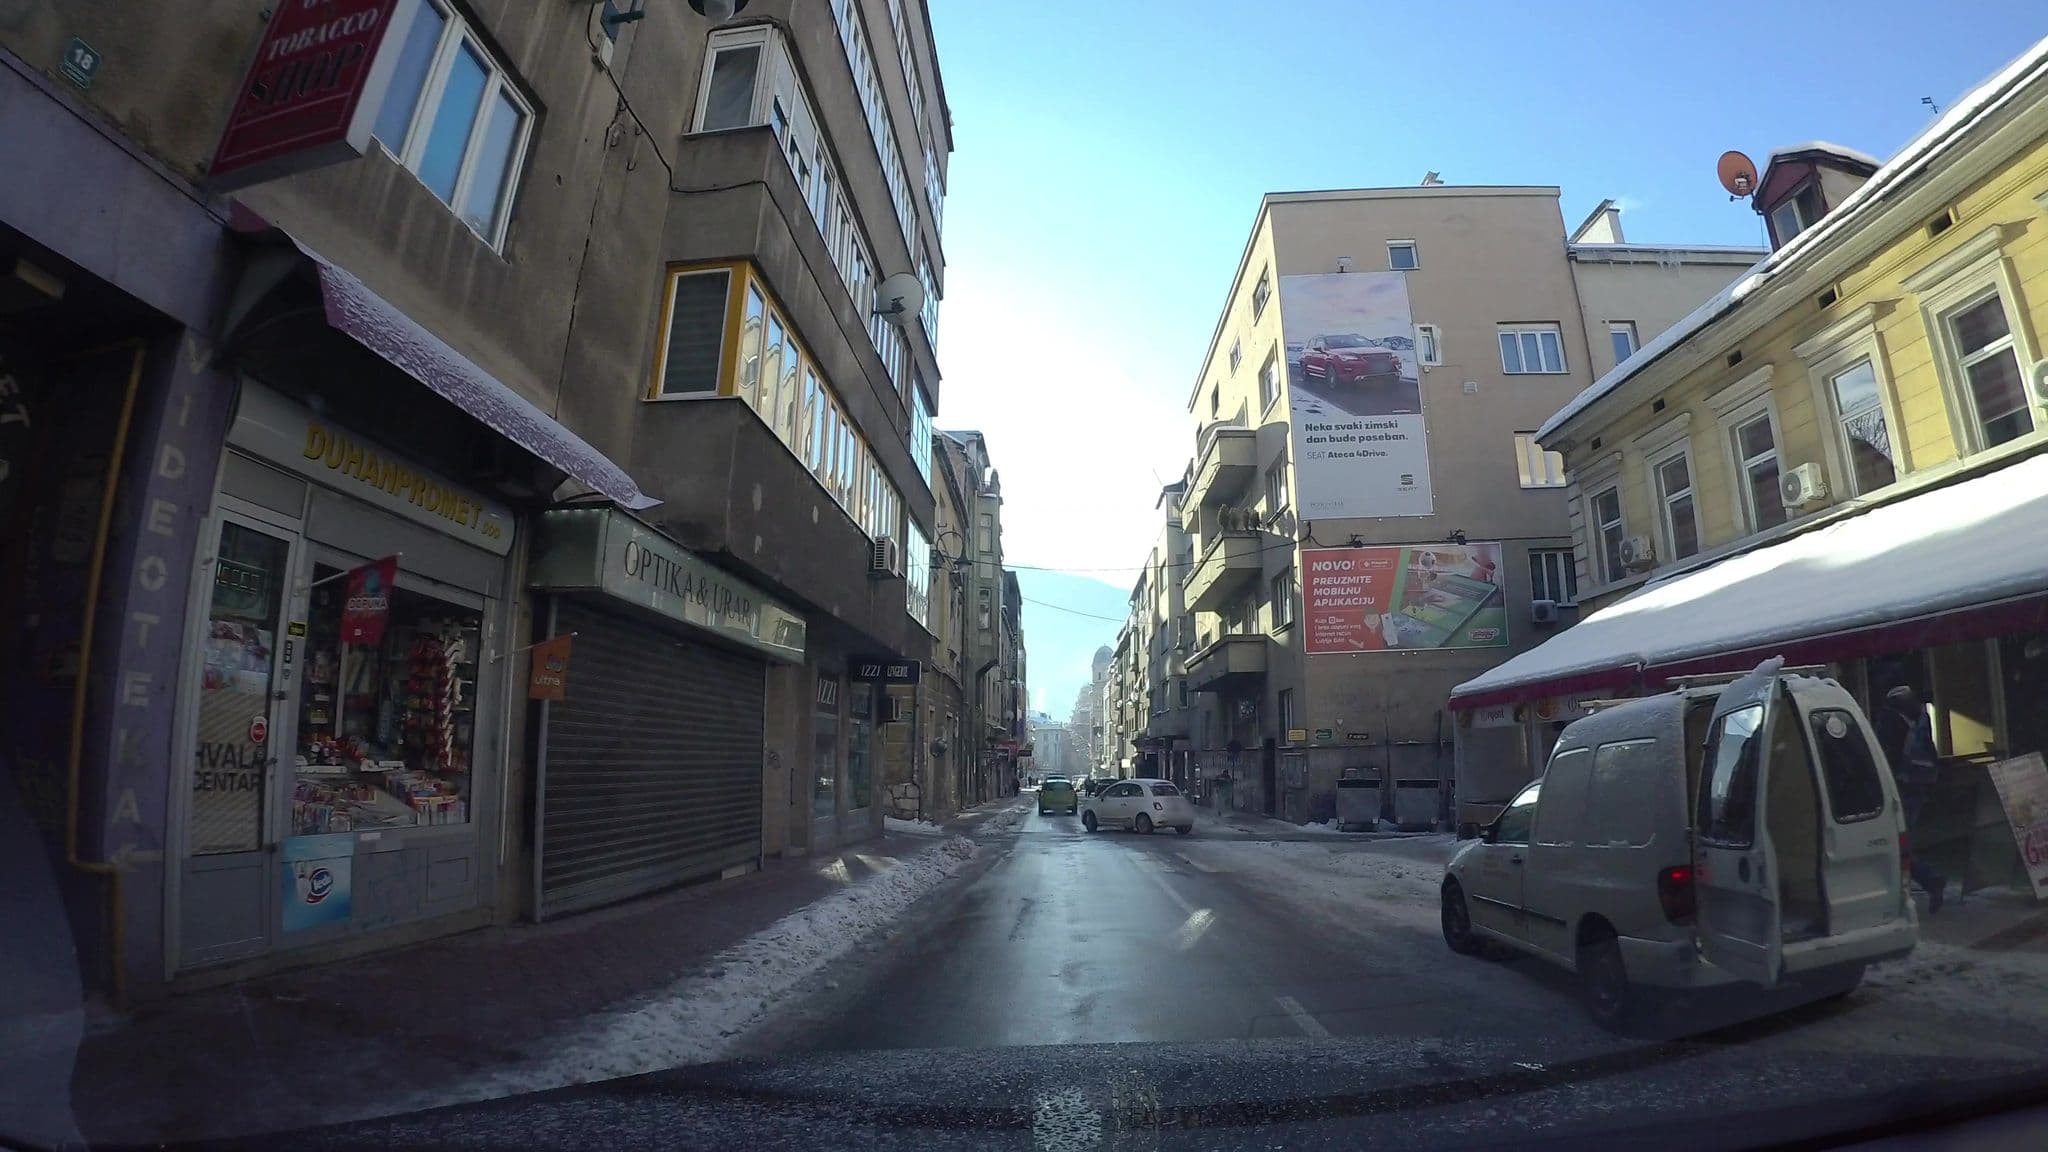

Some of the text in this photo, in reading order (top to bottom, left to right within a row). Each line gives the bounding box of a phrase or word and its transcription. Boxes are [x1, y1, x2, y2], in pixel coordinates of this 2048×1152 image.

[268, 8, 378, 61] TOBACCO
[74, 48, 94, 71] 18
[248, 42, 367, 105] SHOP
[1305, 420, 1398, 432] Neka svaki zimski
[1306, 432, 1409, 444] dan bude poseban.
[1307, 449, 1389, 460] SEAT Ateca 4Drive.
[304, 421, 483, 530] DUHANPROMET
[1312, 559, 1356, 572] NOVO!
[624, 540, 696, 603] OPTIKA
[697, 577, 710, 608] &
[1313, 575, 1373, 586] PREUZMITE
[1313, 586, 1361, 597] MOBILNU
[1314, 597, 1375, 608] APLIKACIJU
[861, 663, 881, 678] IZZI
[817, 678, 838, 705] IZZI
